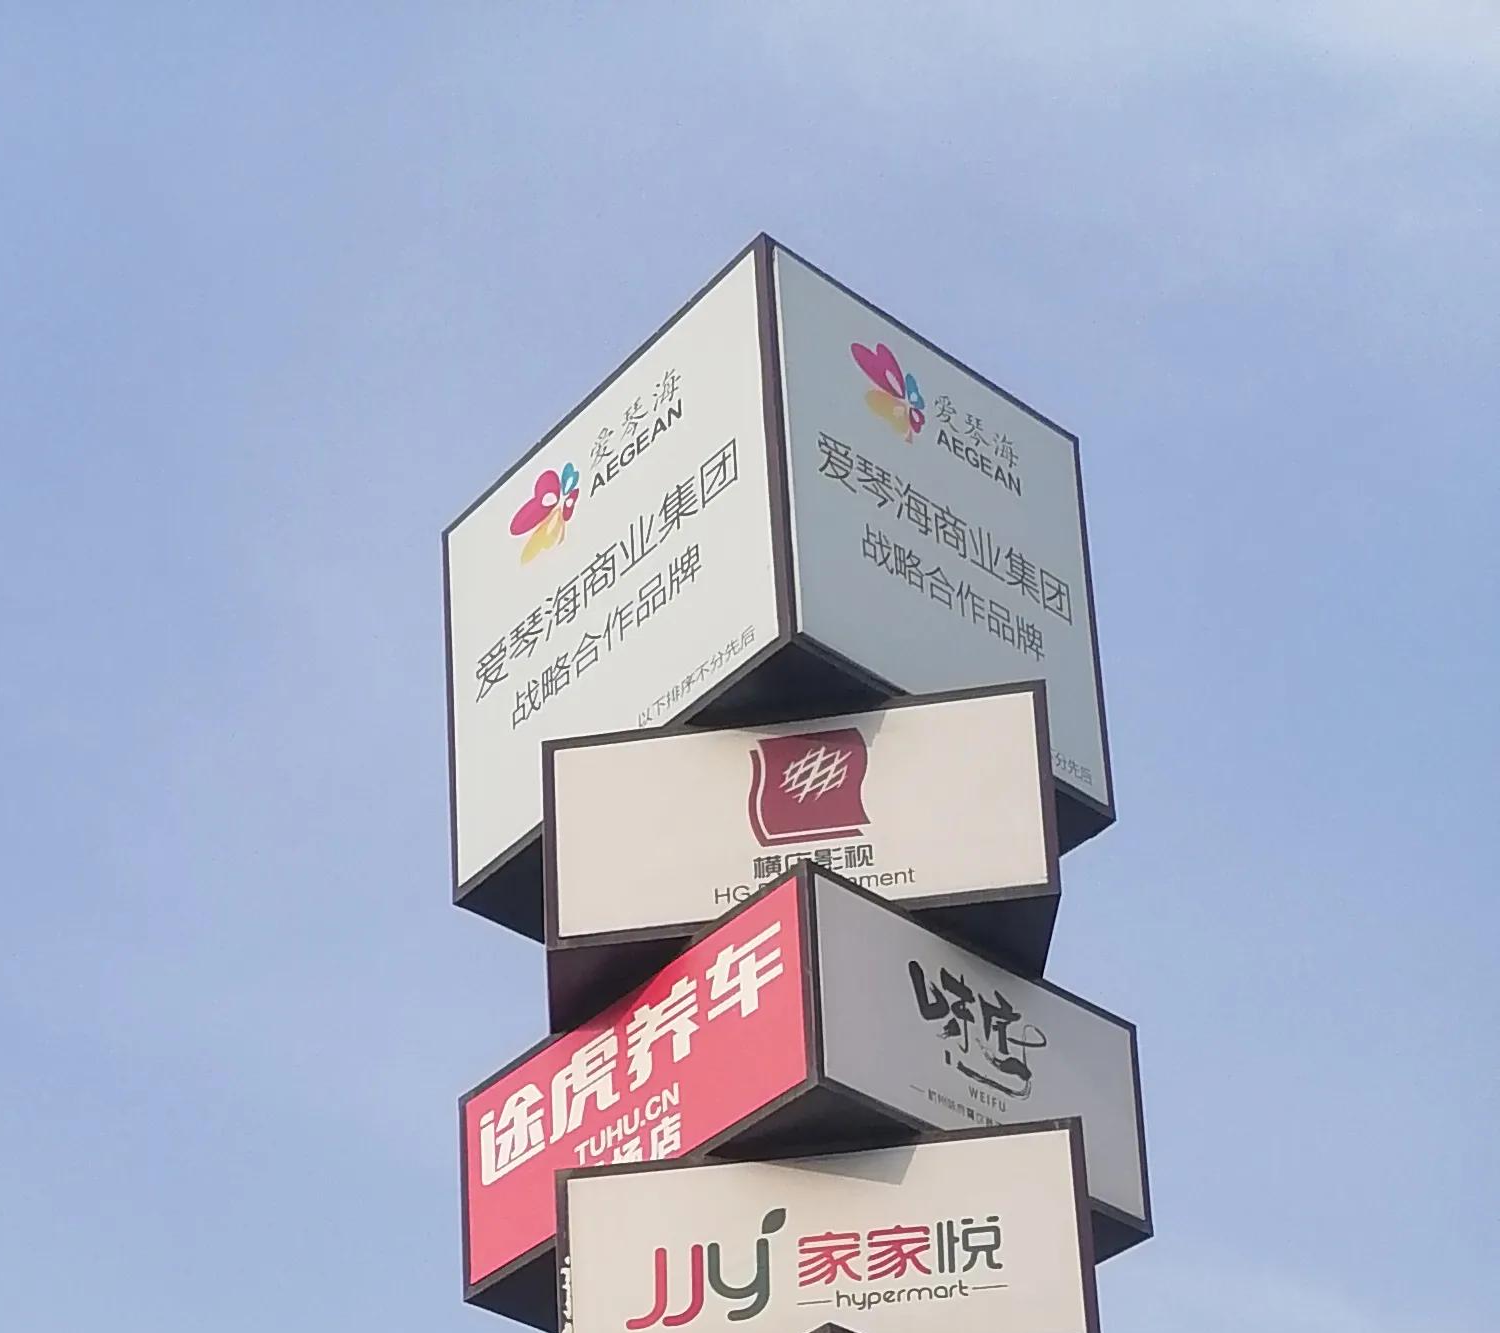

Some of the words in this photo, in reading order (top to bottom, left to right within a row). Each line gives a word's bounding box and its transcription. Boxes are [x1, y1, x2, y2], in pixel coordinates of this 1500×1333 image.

[590, 399, 683, 497] AEGEAN
[936, 429, 1022, 497] AEGEAN
[475, 438, 738, 704] 爱琴海商业集团
[817, 431, 1073, 626] 爱琴海商业集团
[512, 544, 703, 731] 战略合作品牌
[862, 523, 1045, 662] 战略合作品牌
[637, 625, 756, 728] 以下排序不分先后
[1051, 748, 1093, 786] 分先后
[480, 920, 784, 1187] 途虎养车
[968, 1085, 1006, 1112] WEIFU
[574, 1082, 680, 1166] TUHU.CN
[798, 1215, 1003, 1287] 家家悦
[836, 1281, 969, 1310] hypermart
